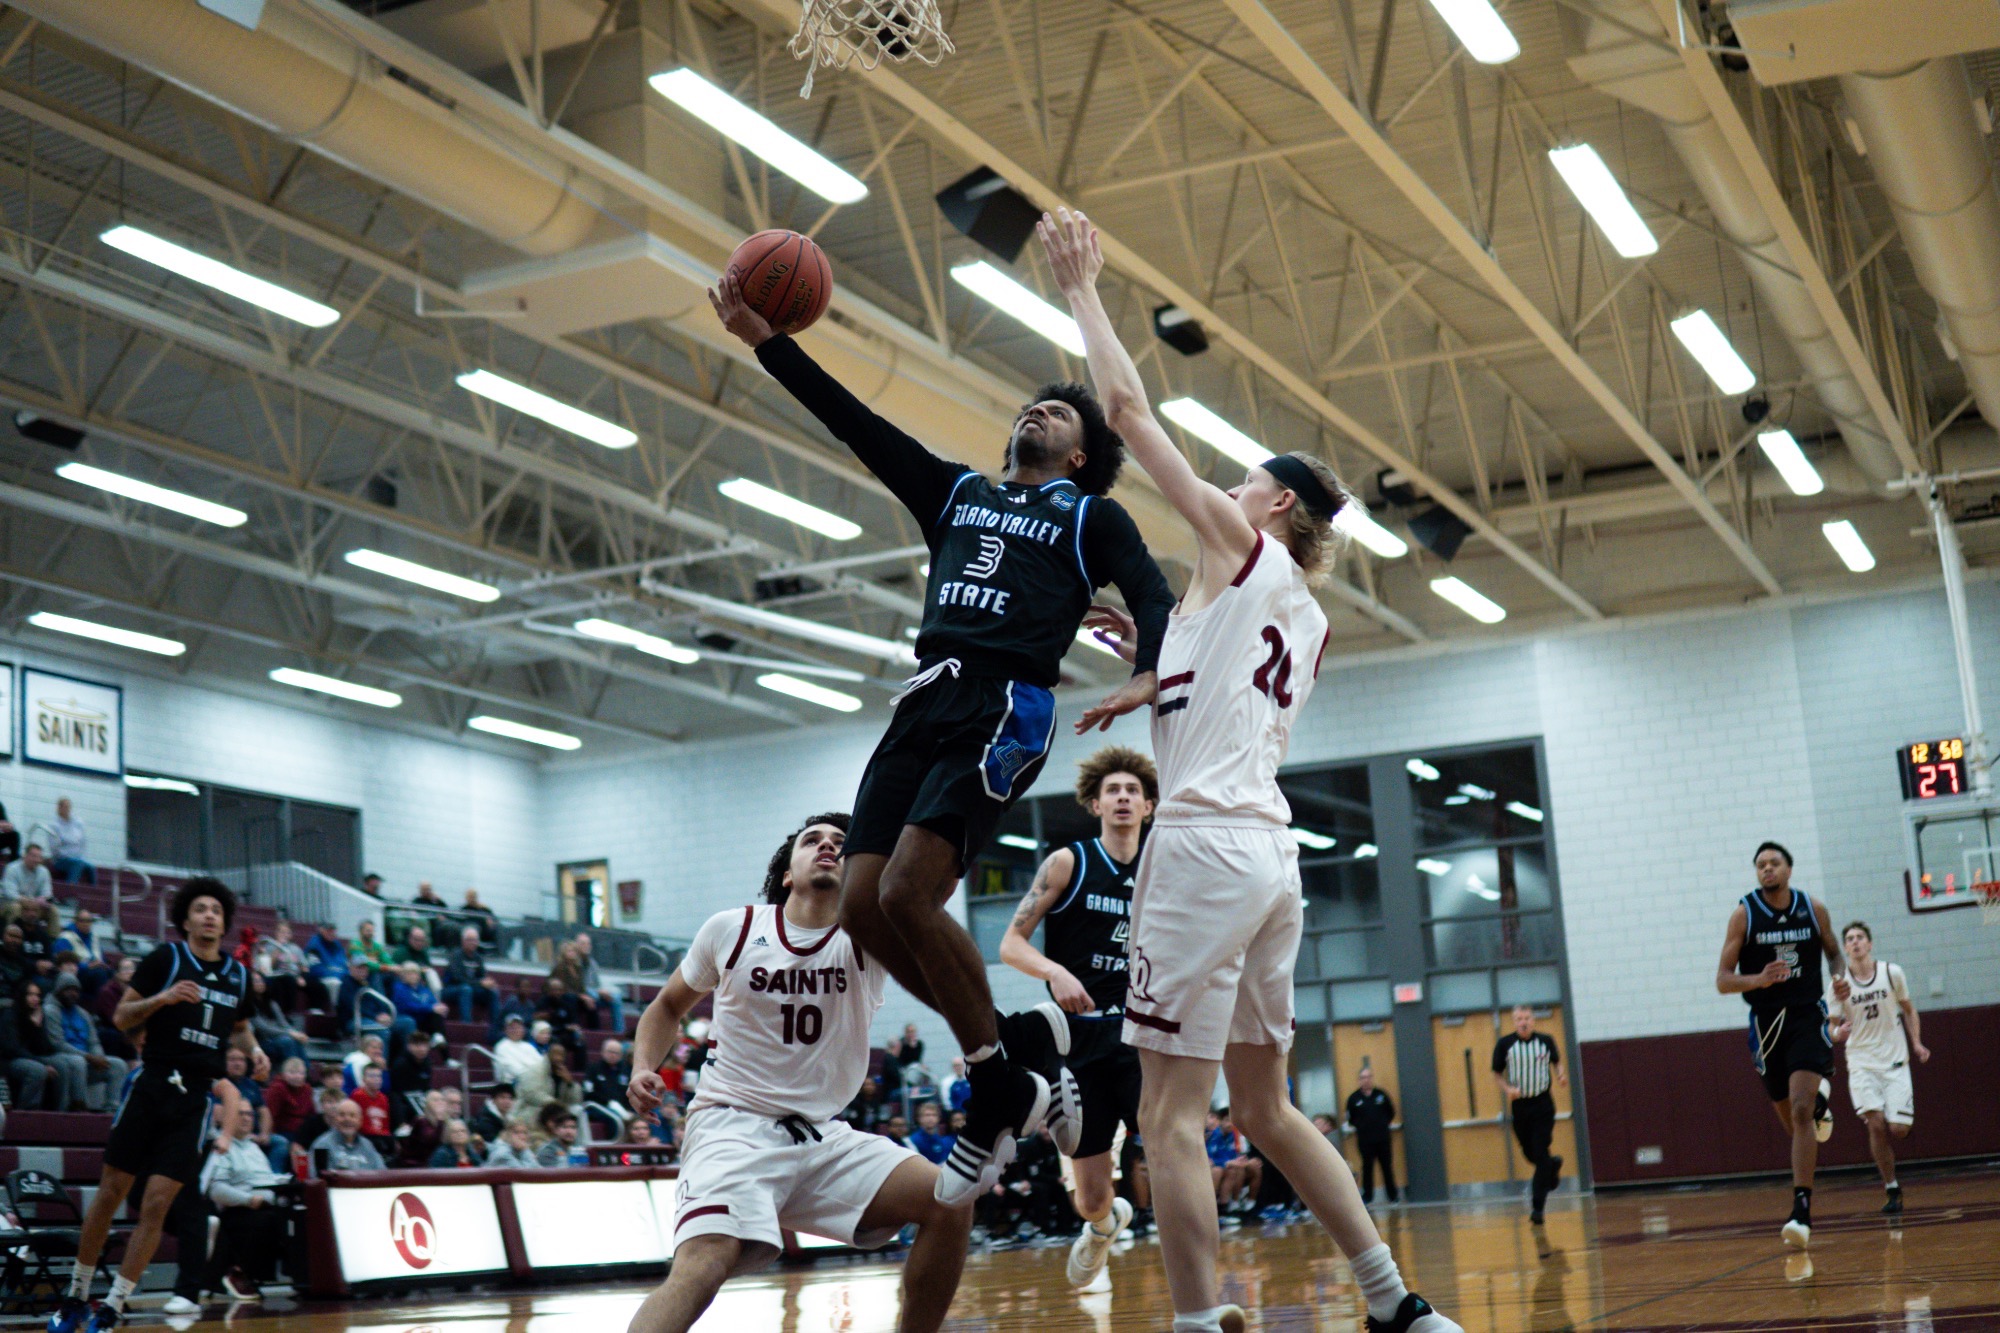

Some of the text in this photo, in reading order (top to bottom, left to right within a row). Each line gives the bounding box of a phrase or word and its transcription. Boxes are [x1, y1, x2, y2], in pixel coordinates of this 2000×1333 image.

[752, 260, 790, 312] ALDING
[952, 504, 1063, 546] GRAND VALLEY
[963, 534, 1006, 579] 3
[938, 581, 1011, 615] STATE
[38, 711, 108, 755] SAINTS
[1918, 761, 1959, 798] 27
[1086, 893, 1124, 915] GRAND
[1110, 920, 1130, 954] 4
[1784, 926, 1811, 943] VALLEY
[1091, 953, 1130, 971] STA
[749, 966, 848, 995] SAINTS
[1851, 988, 1888, 1005] SAINTS
[203, 1002, 214, 1030] 1
[780, 1003, 823, 1046] 10
[180, 1026, 221, 1049] STATE
[392, 1198, 439, 1262] AQ
